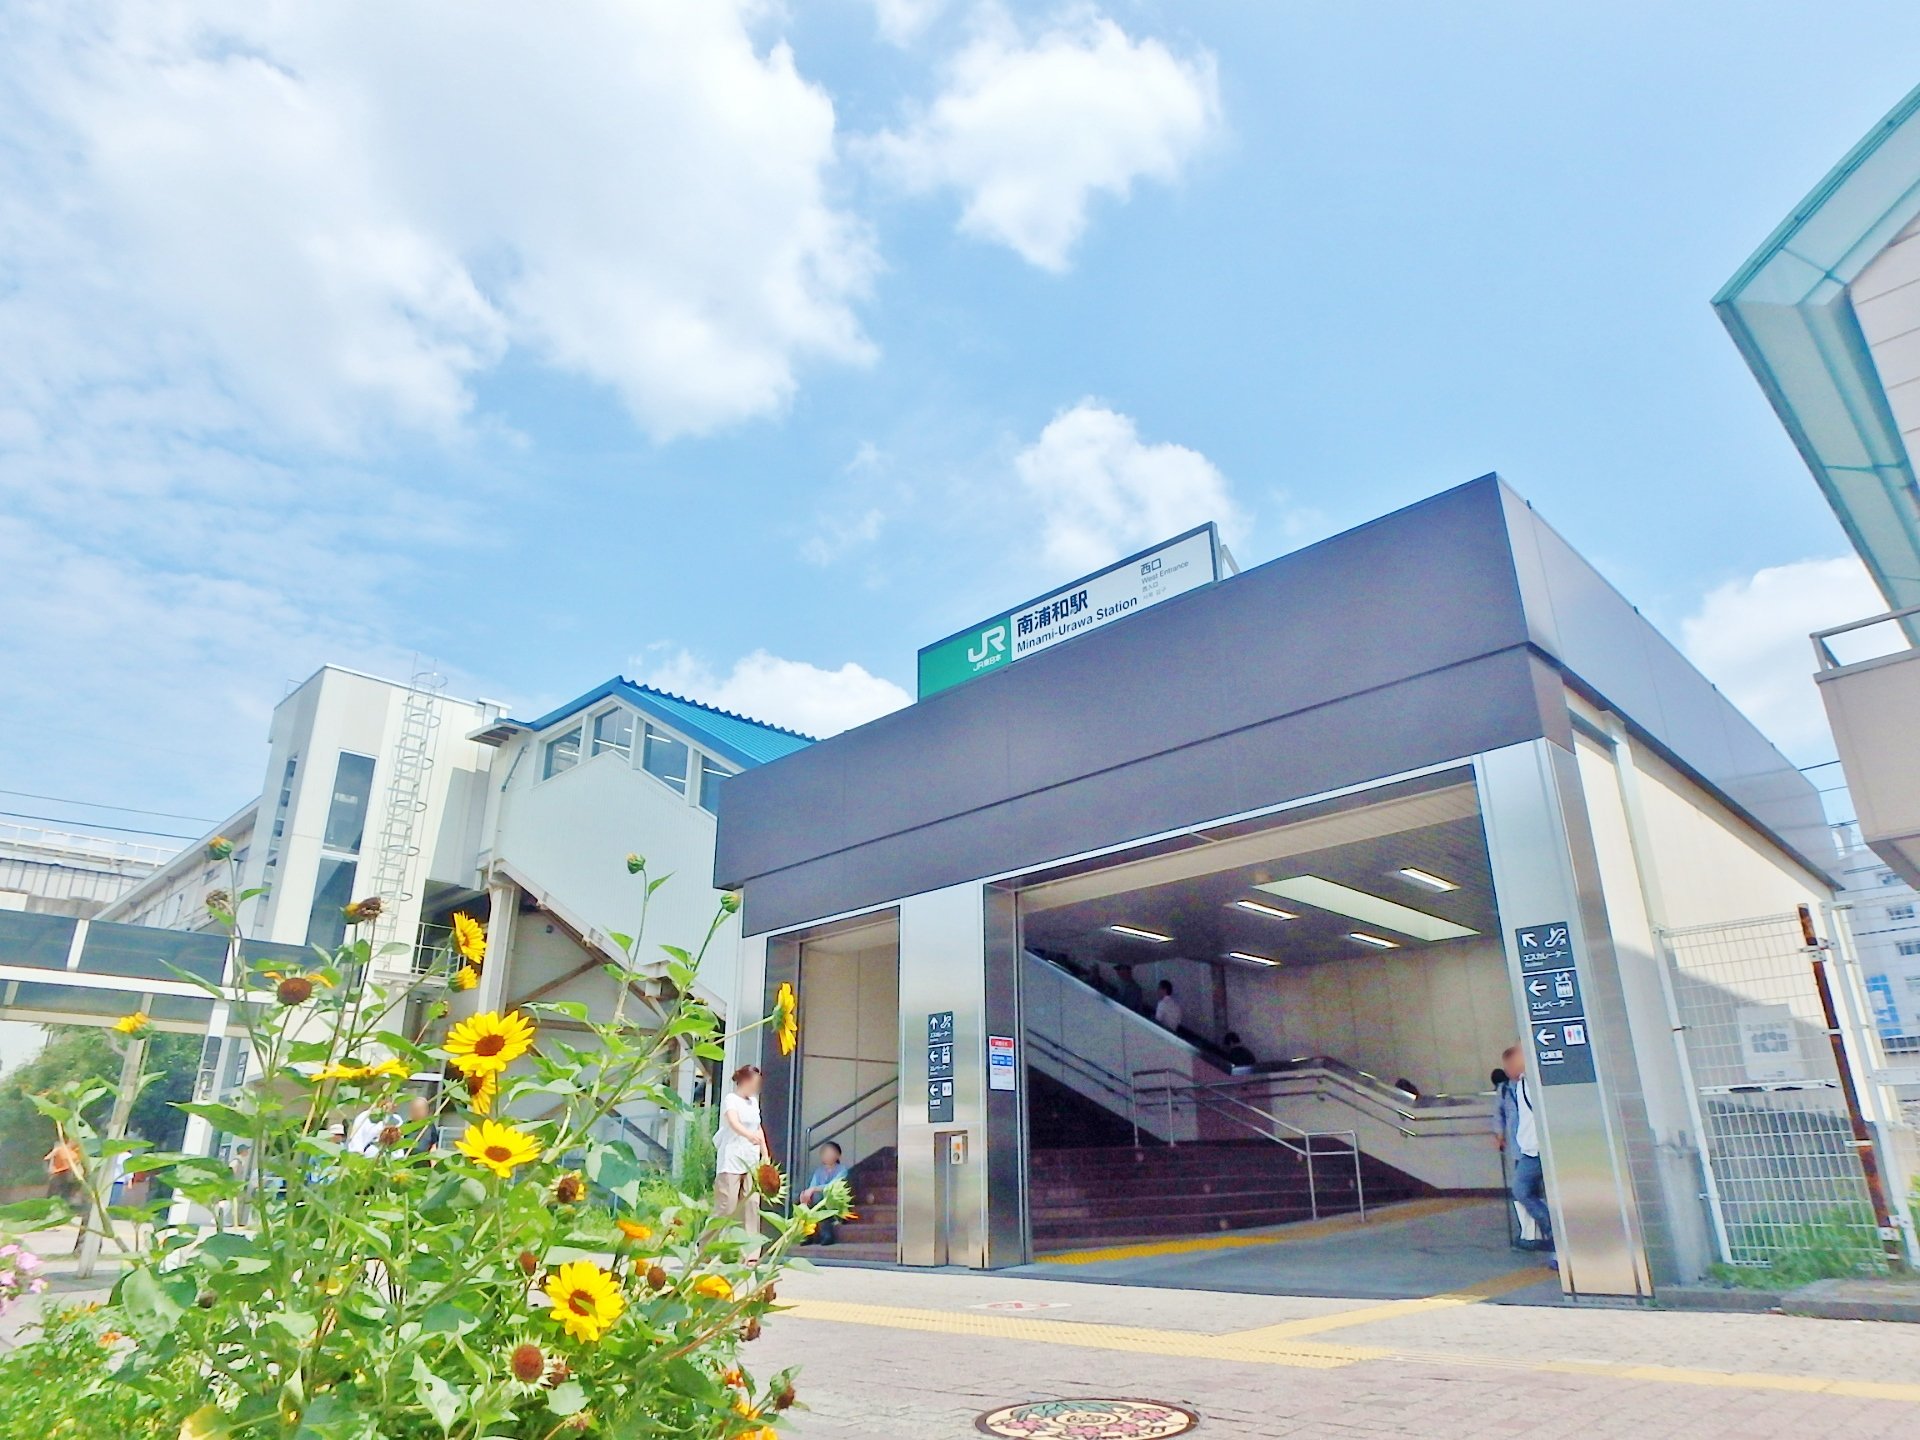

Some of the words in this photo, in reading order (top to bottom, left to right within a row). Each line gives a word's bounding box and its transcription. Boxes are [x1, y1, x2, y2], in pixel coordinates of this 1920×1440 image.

[1140, 558, 1162, 576] 西口
[1141, 573, 1159, 584] West
[1159, 561, 1189, 577] Entrance
[1016, 589, 1089, 638] 南浦和駅
[1016, 615, 1093, 653] Minami-Urawa
[1096, 597, 1138, 621] Station
[967, 625, 1006, 663] JR
